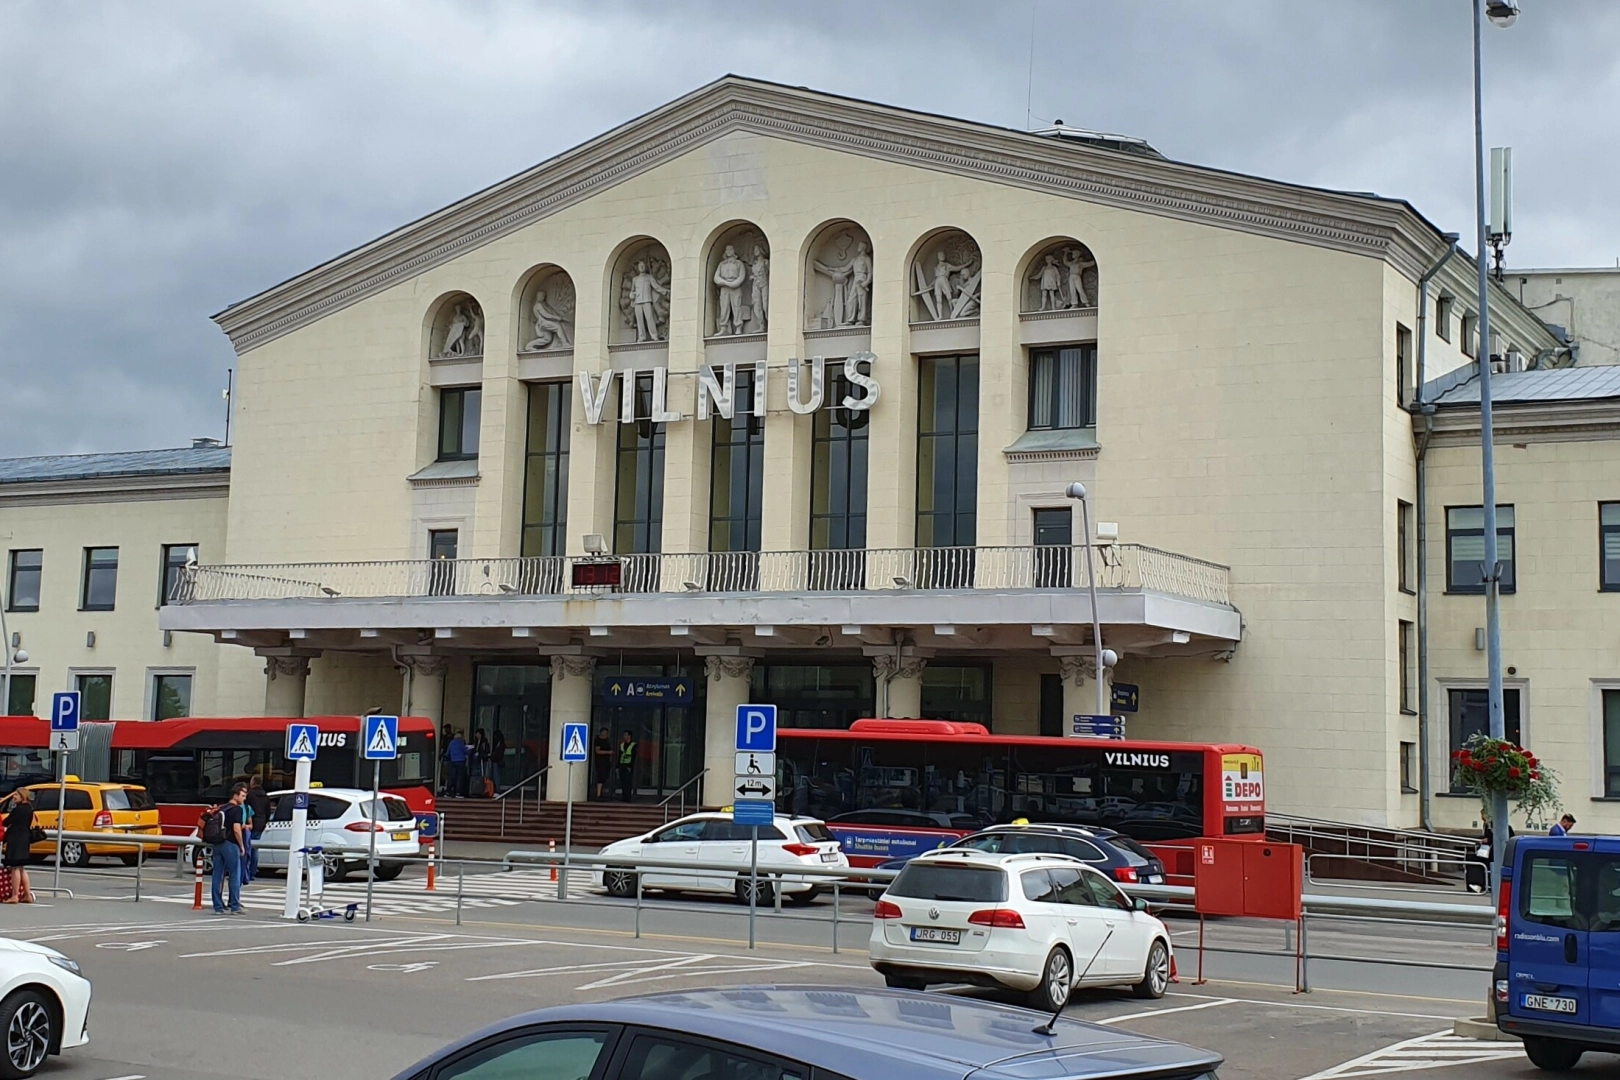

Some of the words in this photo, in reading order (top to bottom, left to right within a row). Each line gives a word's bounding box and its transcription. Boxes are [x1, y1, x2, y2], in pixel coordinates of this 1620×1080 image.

[578, 351, 882, 425] VILNIUS
[626, 682, 635, 696] A
[58, 696, 74, 726] P
[746, 711, 767, 745] P
[1105, 752, 1170, 768] VILNIUS
[1234, 782, 1261, 798] DEPO
[916, 928, 935, 940] JRG
[940, 930, 958, 941] 055
[1514, 931, 1560, 943] radissonblu.com
[1515, 972, 1535, 980] OPEL
[1526, 995, 1549, 1009] GNE
[1555, 999, 1574, 1012] 730
